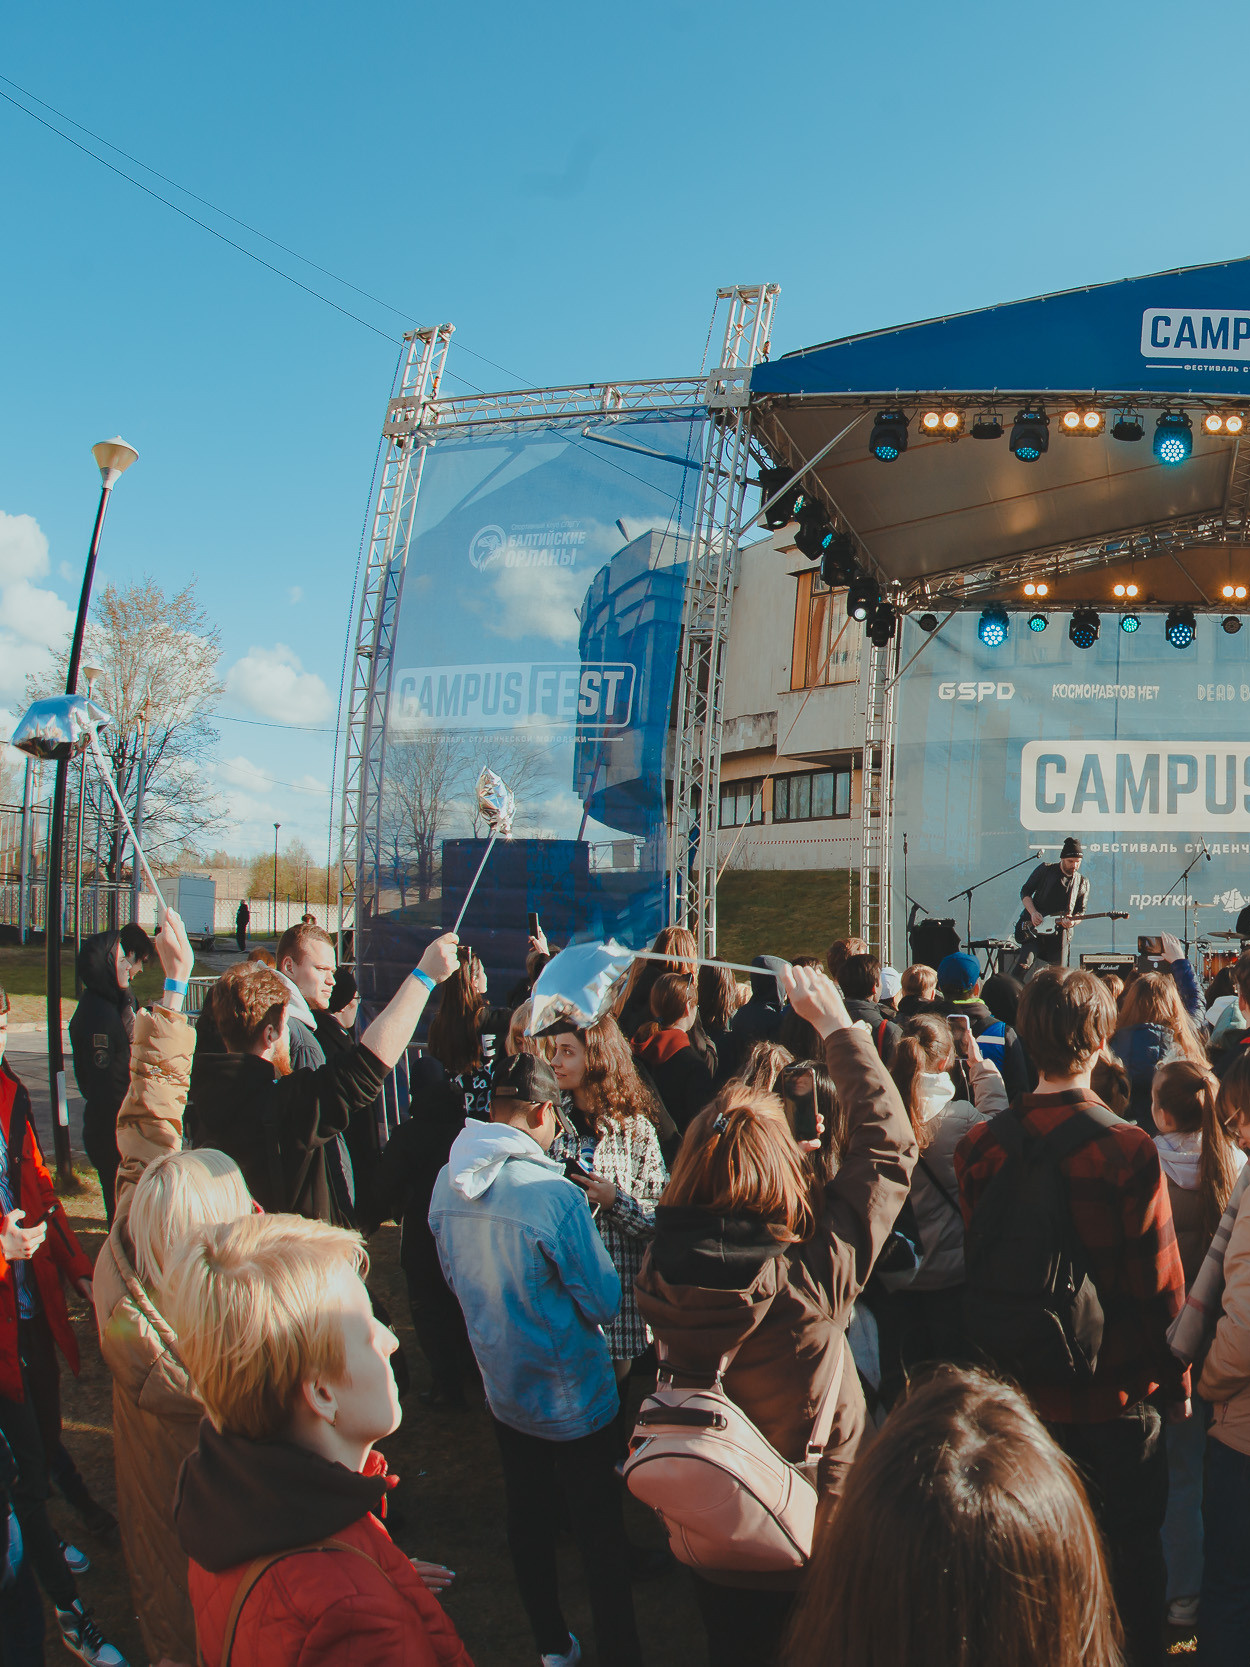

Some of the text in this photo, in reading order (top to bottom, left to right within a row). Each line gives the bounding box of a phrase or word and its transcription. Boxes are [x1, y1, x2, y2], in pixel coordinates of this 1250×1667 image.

[1184, 364, 1240, 374] ФЕСТИВАЛЬ
[508, 530, 587, 547] БАЛТИЙСКИЕ
[504, 548, 577, 568] ОРЛАНЫ
[400, 670, 625, 718] CAMPUS FEST
[938, 682, 1016, 702] GSPD
[1052, 684, 1160, 701] КОСМОНАВТОВ НЕТ
[1197, 683, 1236, 702] DEAD
[1090, 843, 1177, 853] ФЕСТИВАЛЬ
[1129, 894, 1193, 910] прятки
